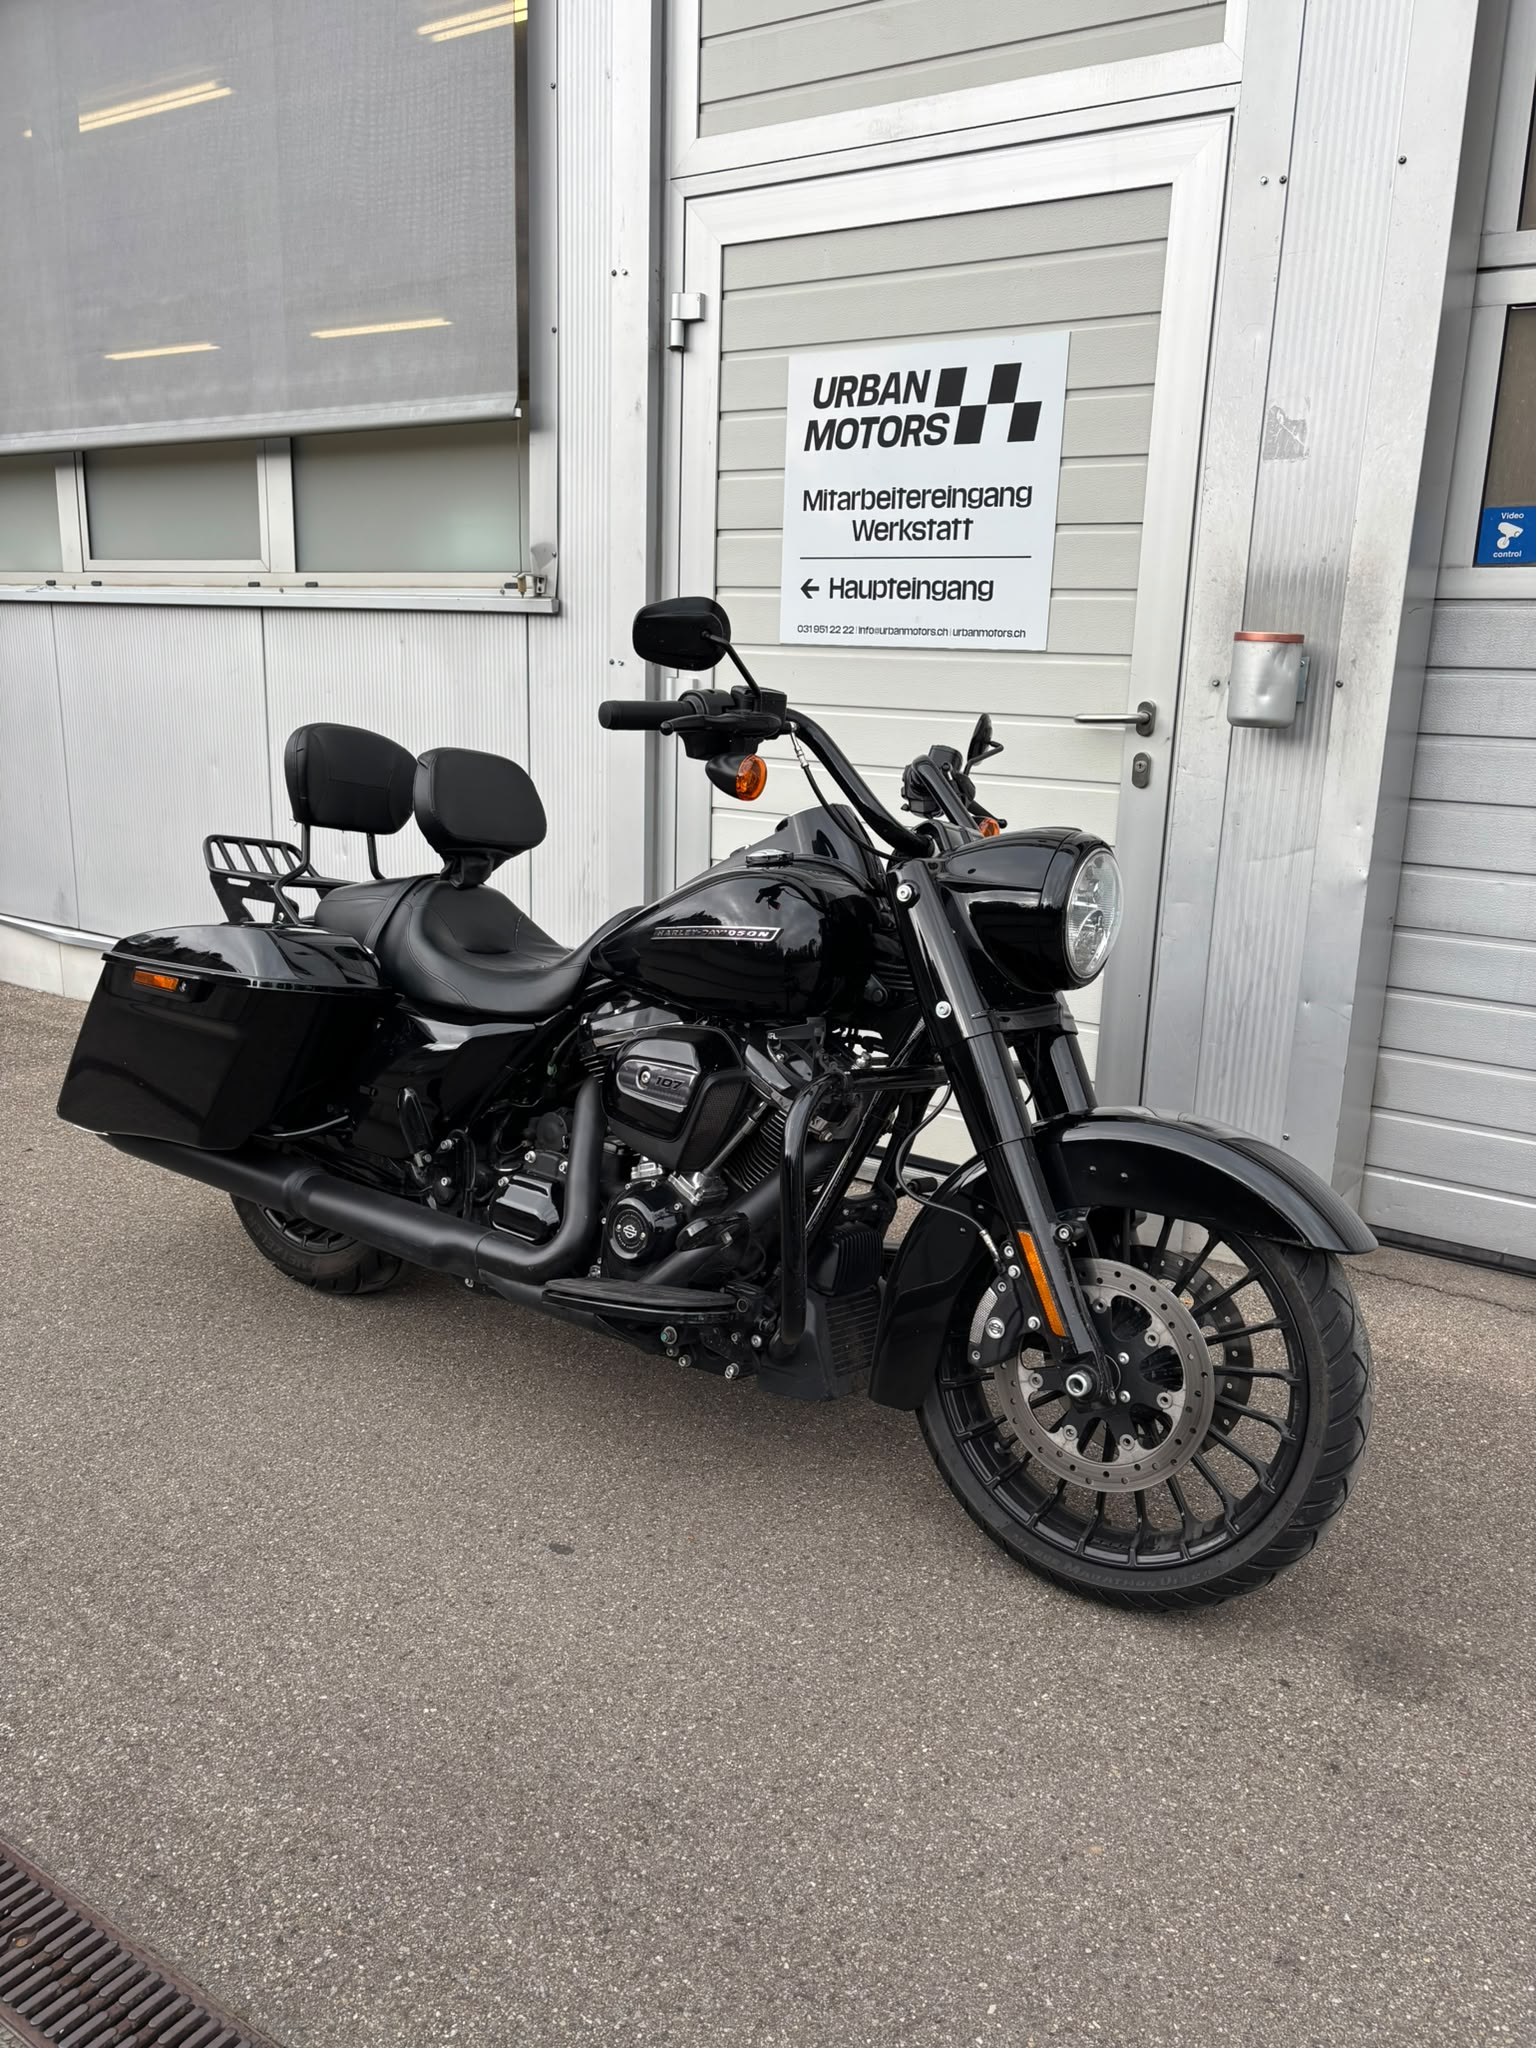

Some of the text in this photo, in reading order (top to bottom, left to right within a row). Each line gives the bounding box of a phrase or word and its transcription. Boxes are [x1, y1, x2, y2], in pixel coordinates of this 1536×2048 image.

[813, 369, 931, 409] URBAN
[804, 412, 950, 452] MOTORS
[802, 485, 1033, 512] Mitarbeitereingang
[852, 517, 974, 542] Werkstatt
[1492, 550, 1522, 558] control
[829, 576, 994, 602] Haupteingang
[952, 627, 1027, 639] urbanmotors.ch
[655, 1076, 685, 1090] 107
